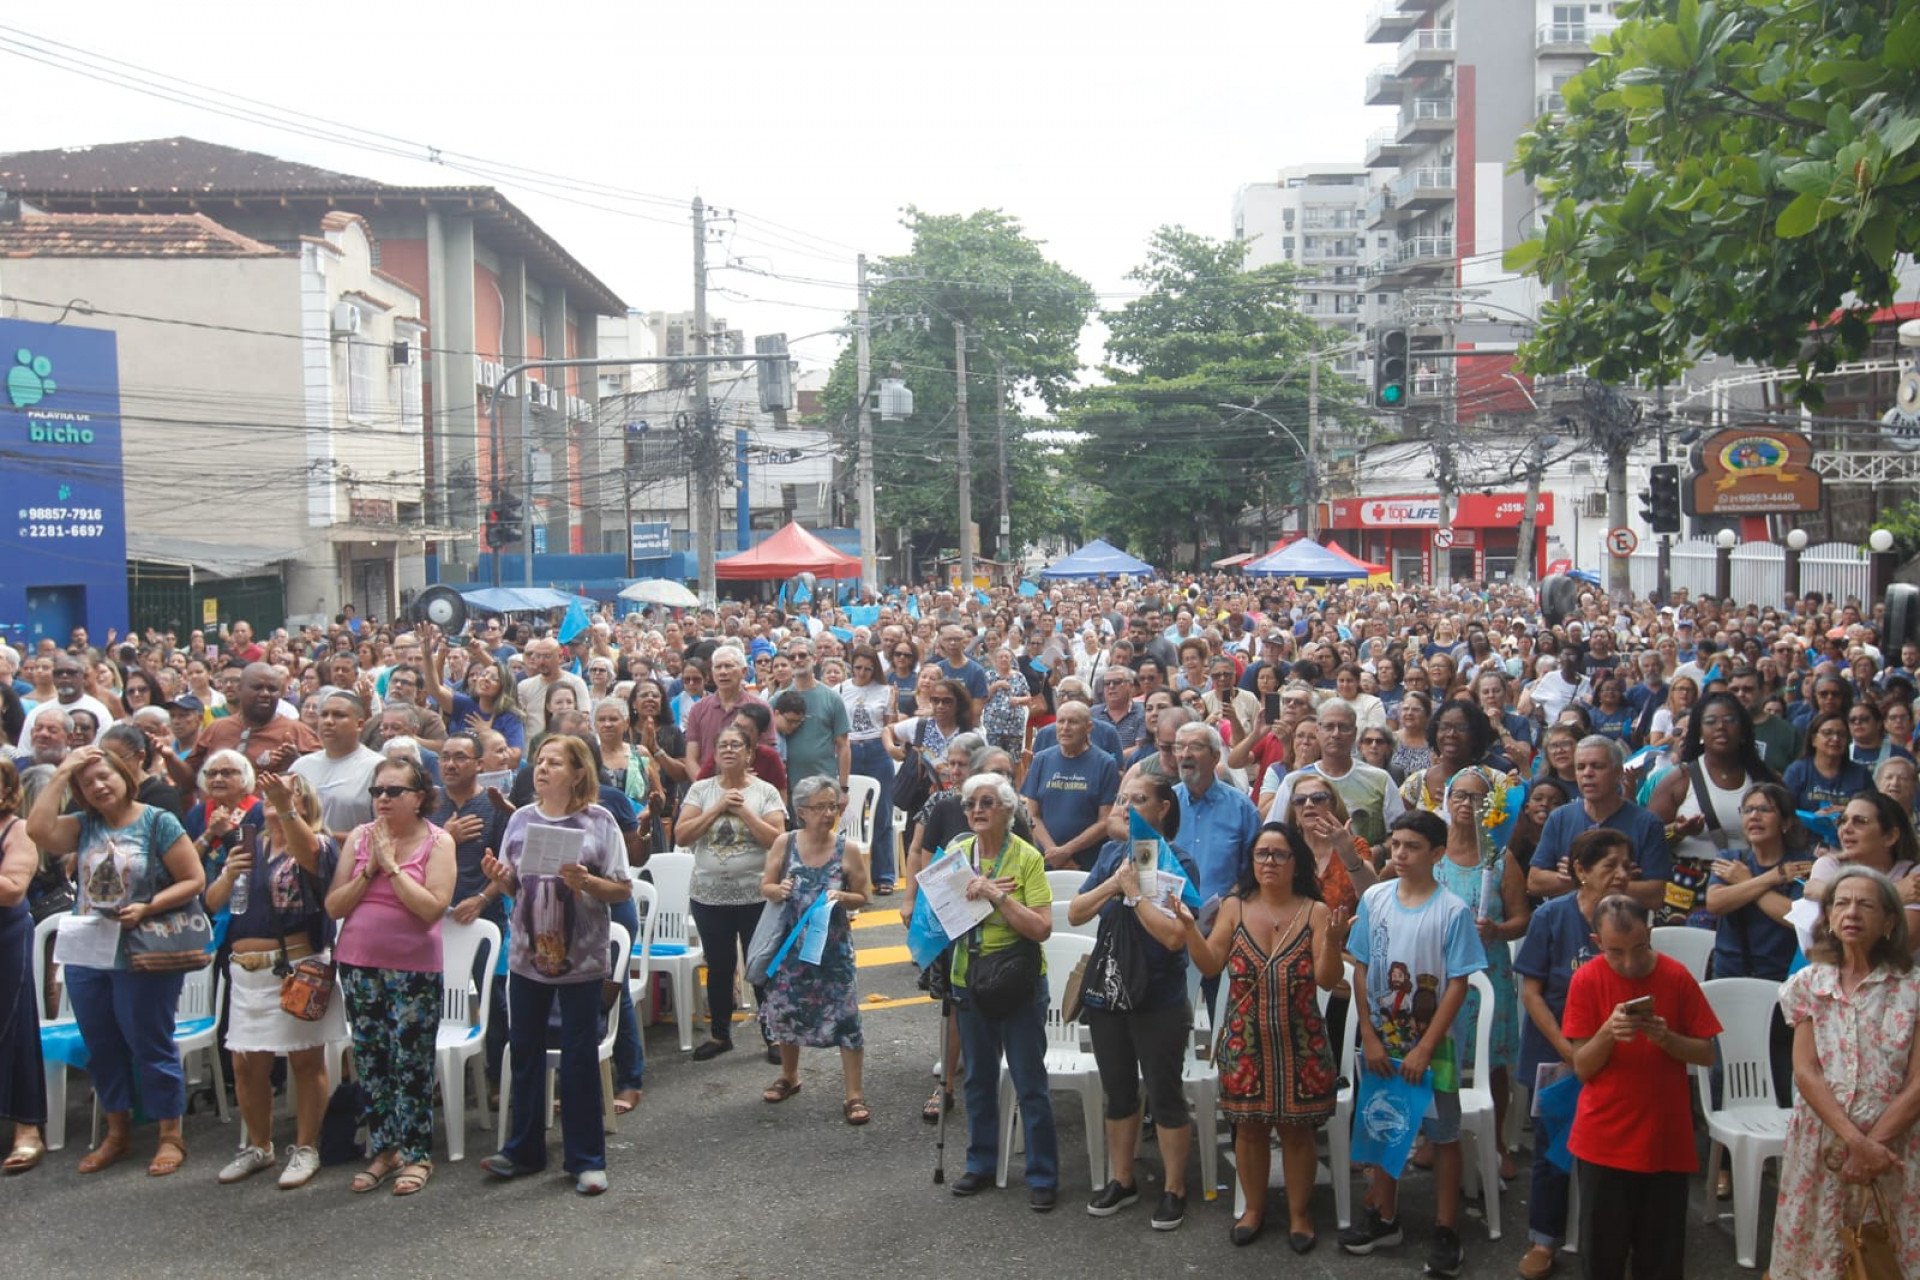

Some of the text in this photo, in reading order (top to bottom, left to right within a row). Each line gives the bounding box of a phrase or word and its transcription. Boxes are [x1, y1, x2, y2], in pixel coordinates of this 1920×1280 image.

[29, 420, 94, 443] bicho
[28, 507, 102, 521] 98857-7916
[29, 524, 104, 538] 2281-6697
